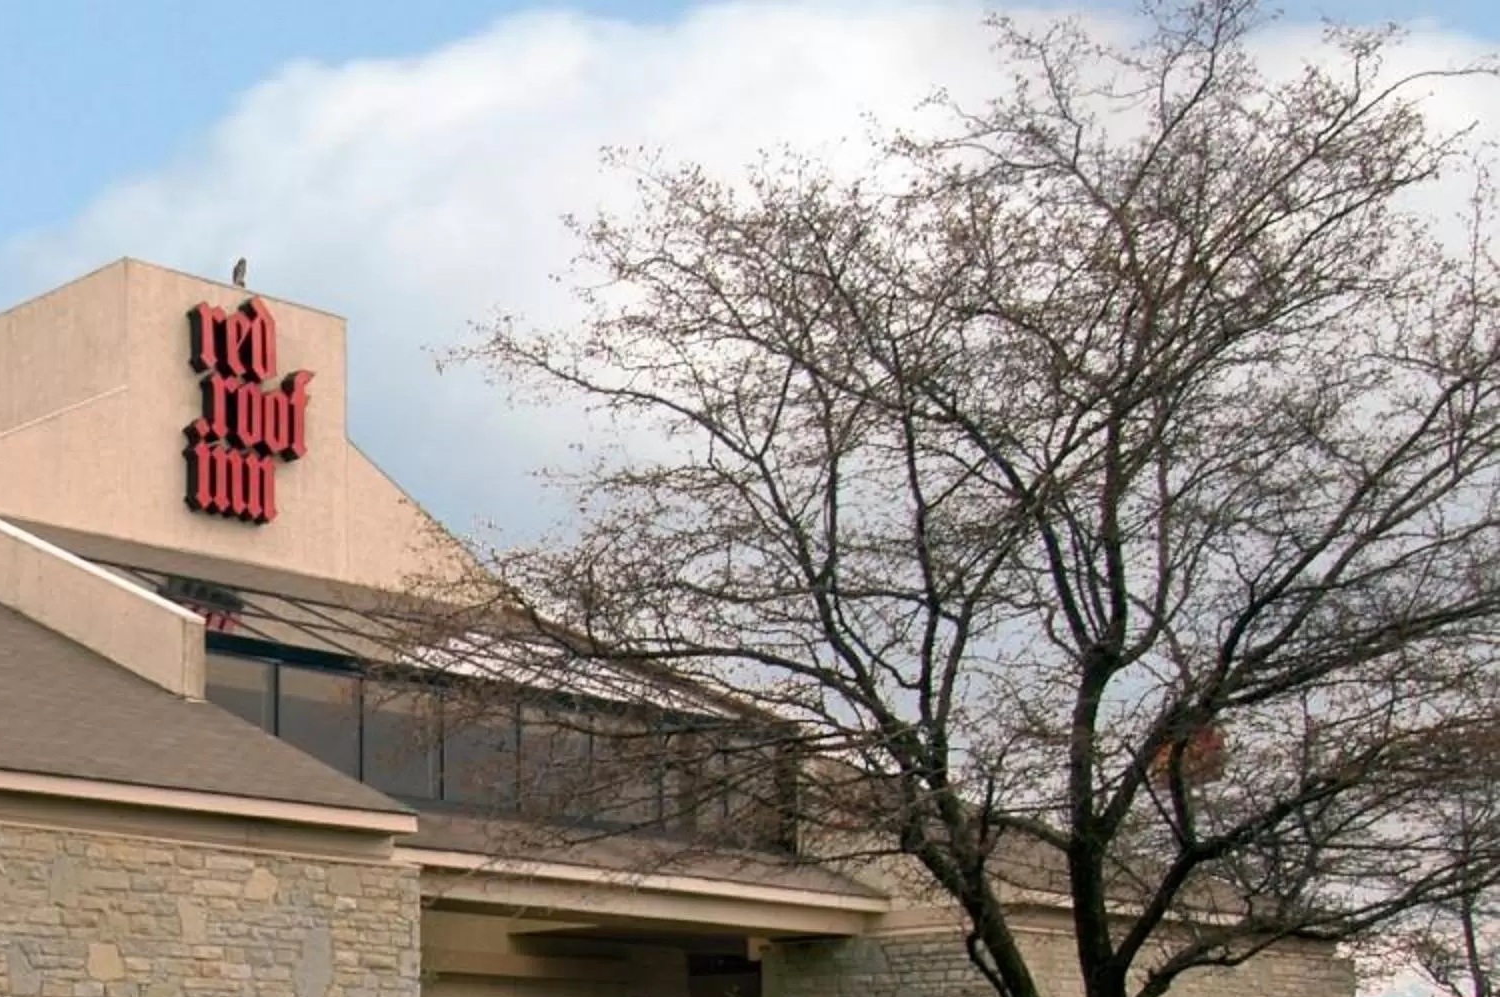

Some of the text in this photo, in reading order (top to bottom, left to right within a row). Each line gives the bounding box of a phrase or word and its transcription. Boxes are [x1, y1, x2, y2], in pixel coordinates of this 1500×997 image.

[188, 295, 277, 381] red
[201, 369, 315, 461] roof
[183, 416, 278, 524] inn
